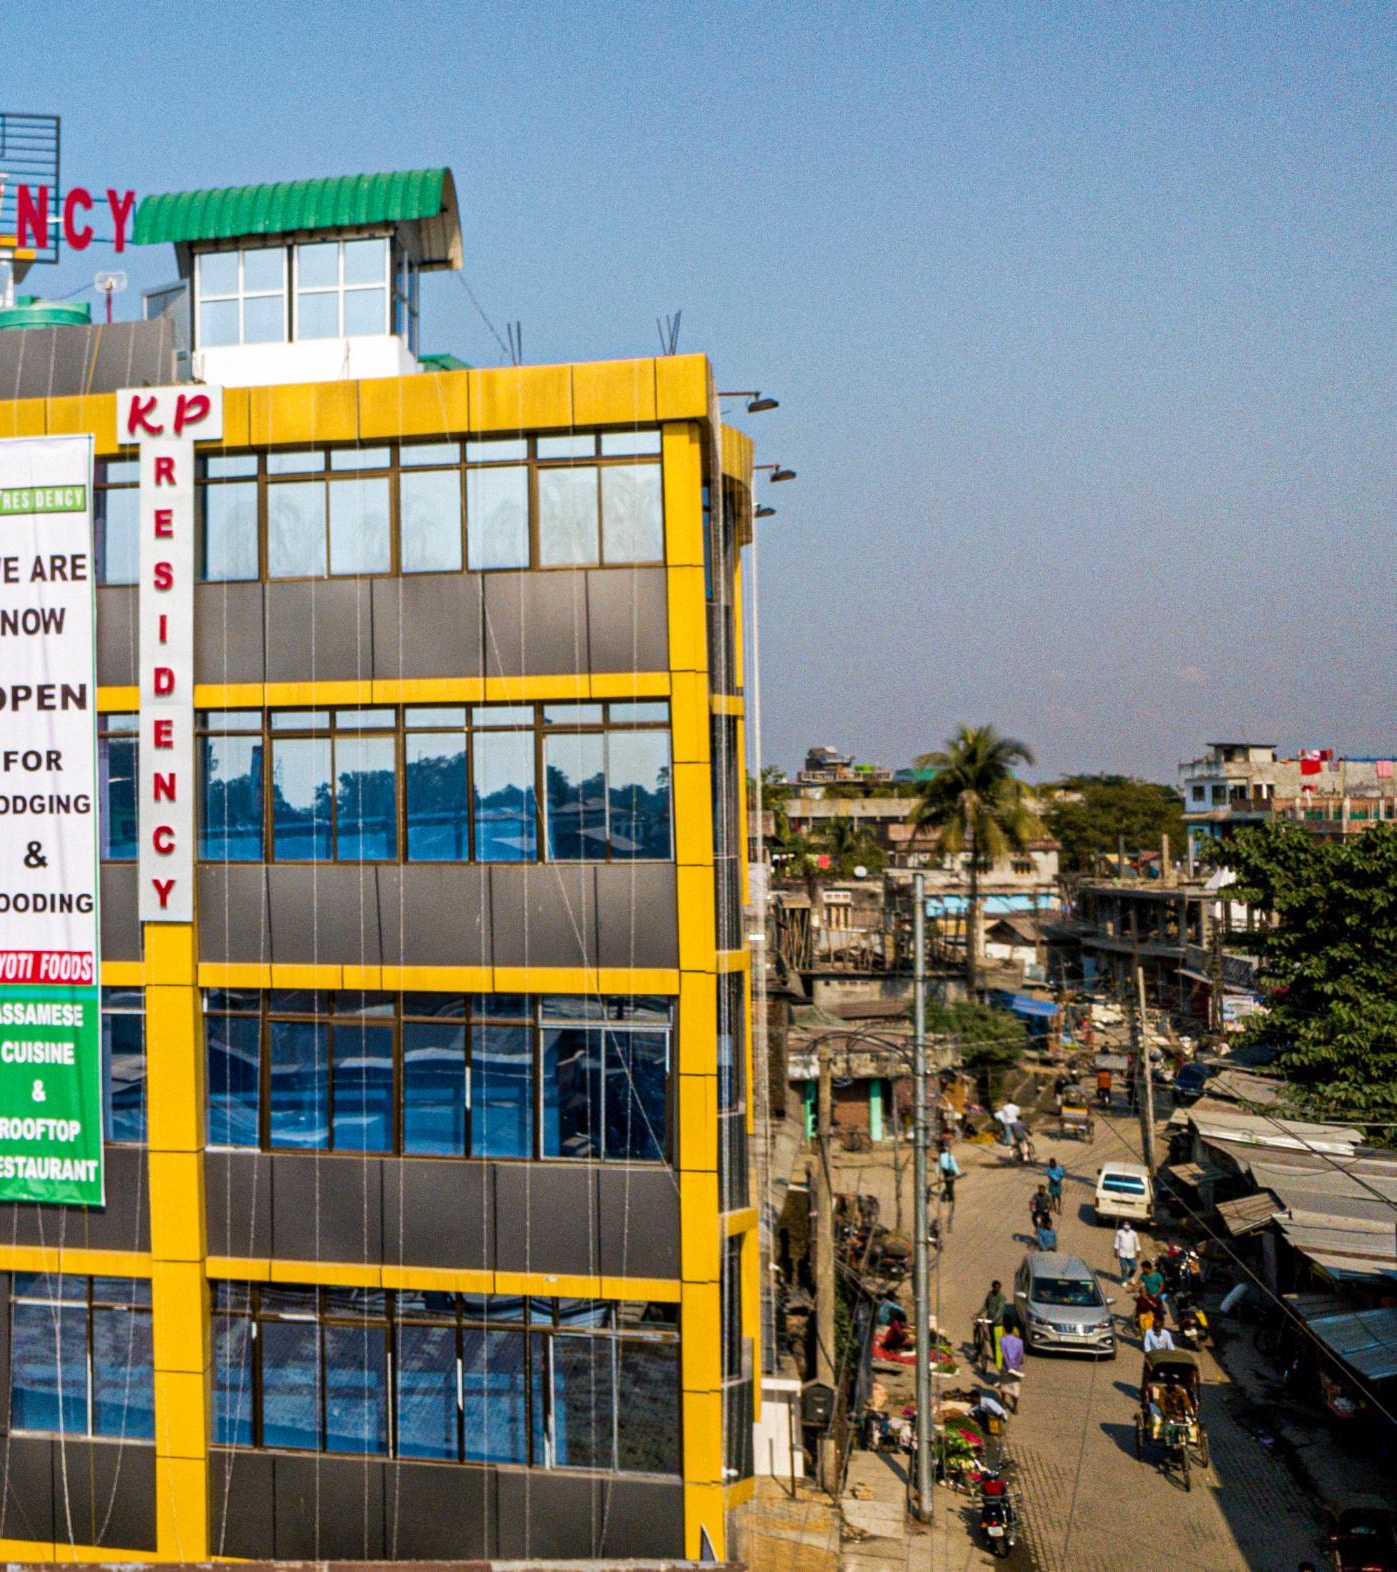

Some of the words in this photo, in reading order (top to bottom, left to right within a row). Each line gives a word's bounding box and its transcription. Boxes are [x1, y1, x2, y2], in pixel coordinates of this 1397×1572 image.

[3, 489, 83, 510] RESDENCY
[30, 555, 87, 582] ARE
[0, 607, 66, 636] NOW
[151, 456, 177, 909] RESIDENCY
[3, 751, 63, 772] FOR
[23, 841, 48, 868] &
[39, 953, 92, 981] FOODS
[1, 1041, 75, 1065] CUISINE
[31, 1080, 46, 1102] &
